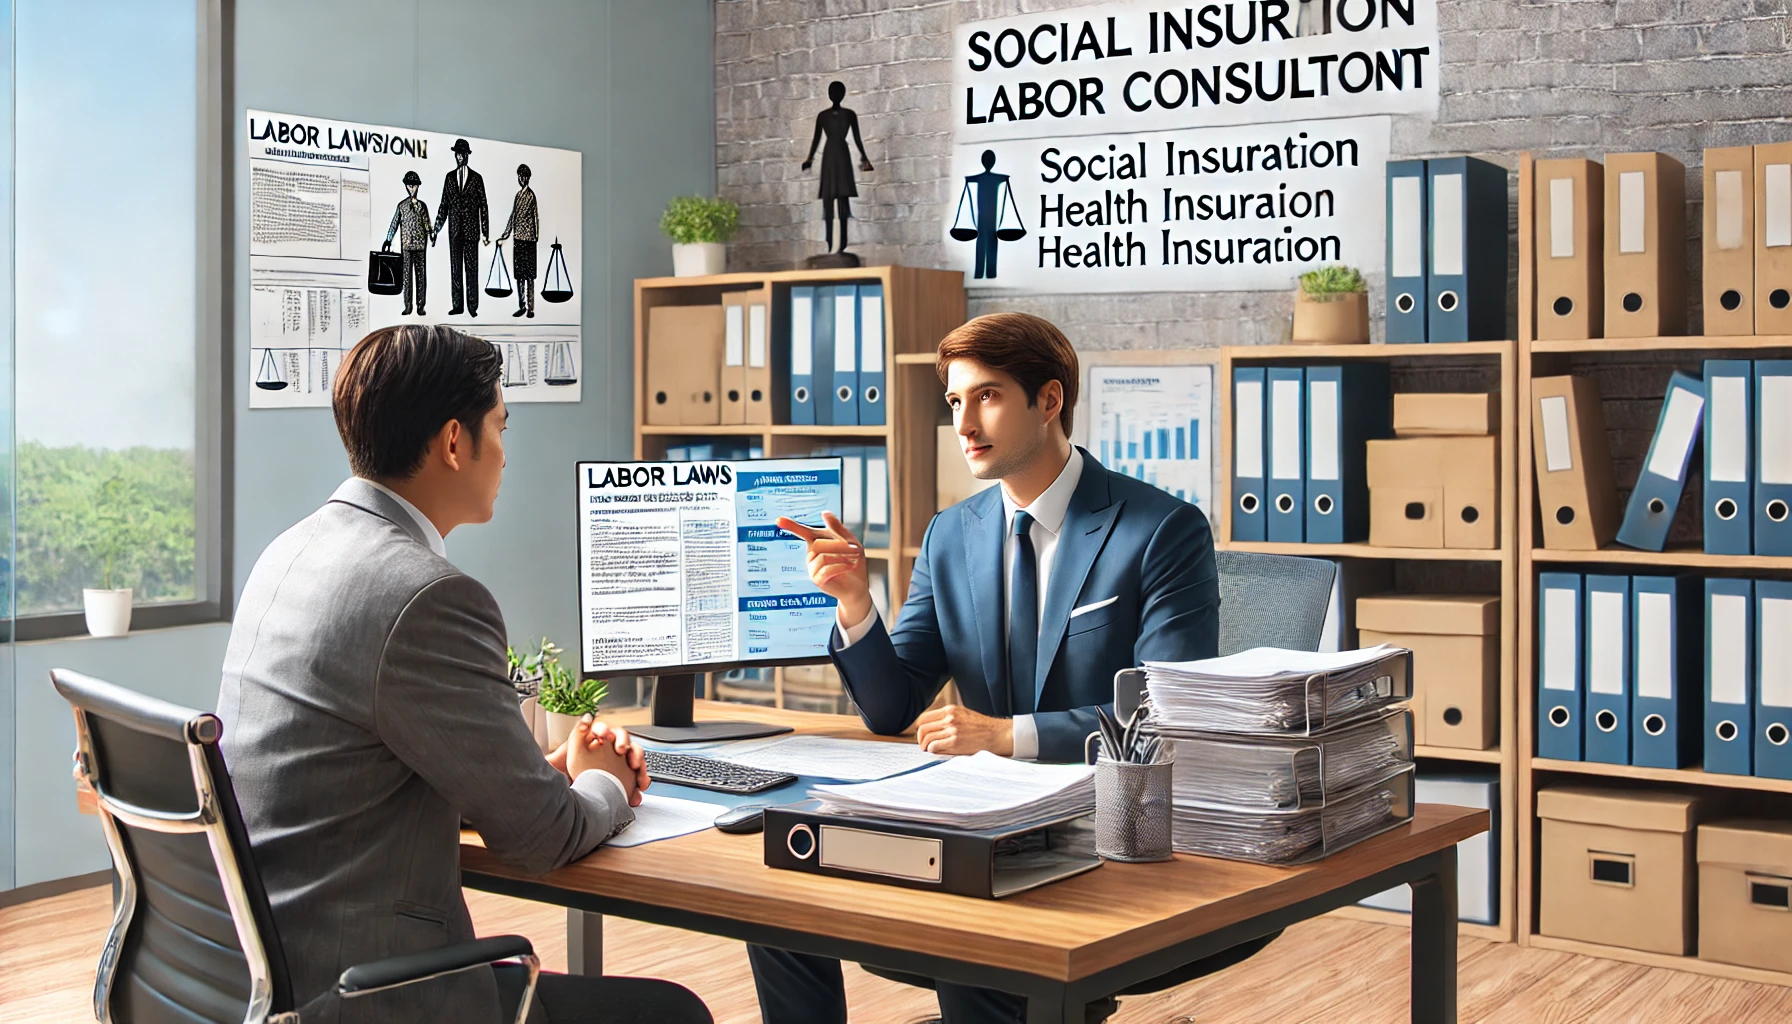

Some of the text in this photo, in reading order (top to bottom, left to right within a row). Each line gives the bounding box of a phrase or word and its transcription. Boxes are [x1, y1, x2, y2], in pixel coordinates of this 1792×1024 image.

[968, 17, 1133, 72] SOCIAL
[966, 46, 1430, 125] LABOR CONSULTONT
[250, 118, 321, 149] LABOR
[1040, 131, 1359, 184] Social Insuration
[1040, 182, 1334, 229] Health Insuraion
[1038, 225, 1341, 269] Health Insuration
[588, 466, 666, 488] LABOR
[673, 464, 732, 486] LAWS
